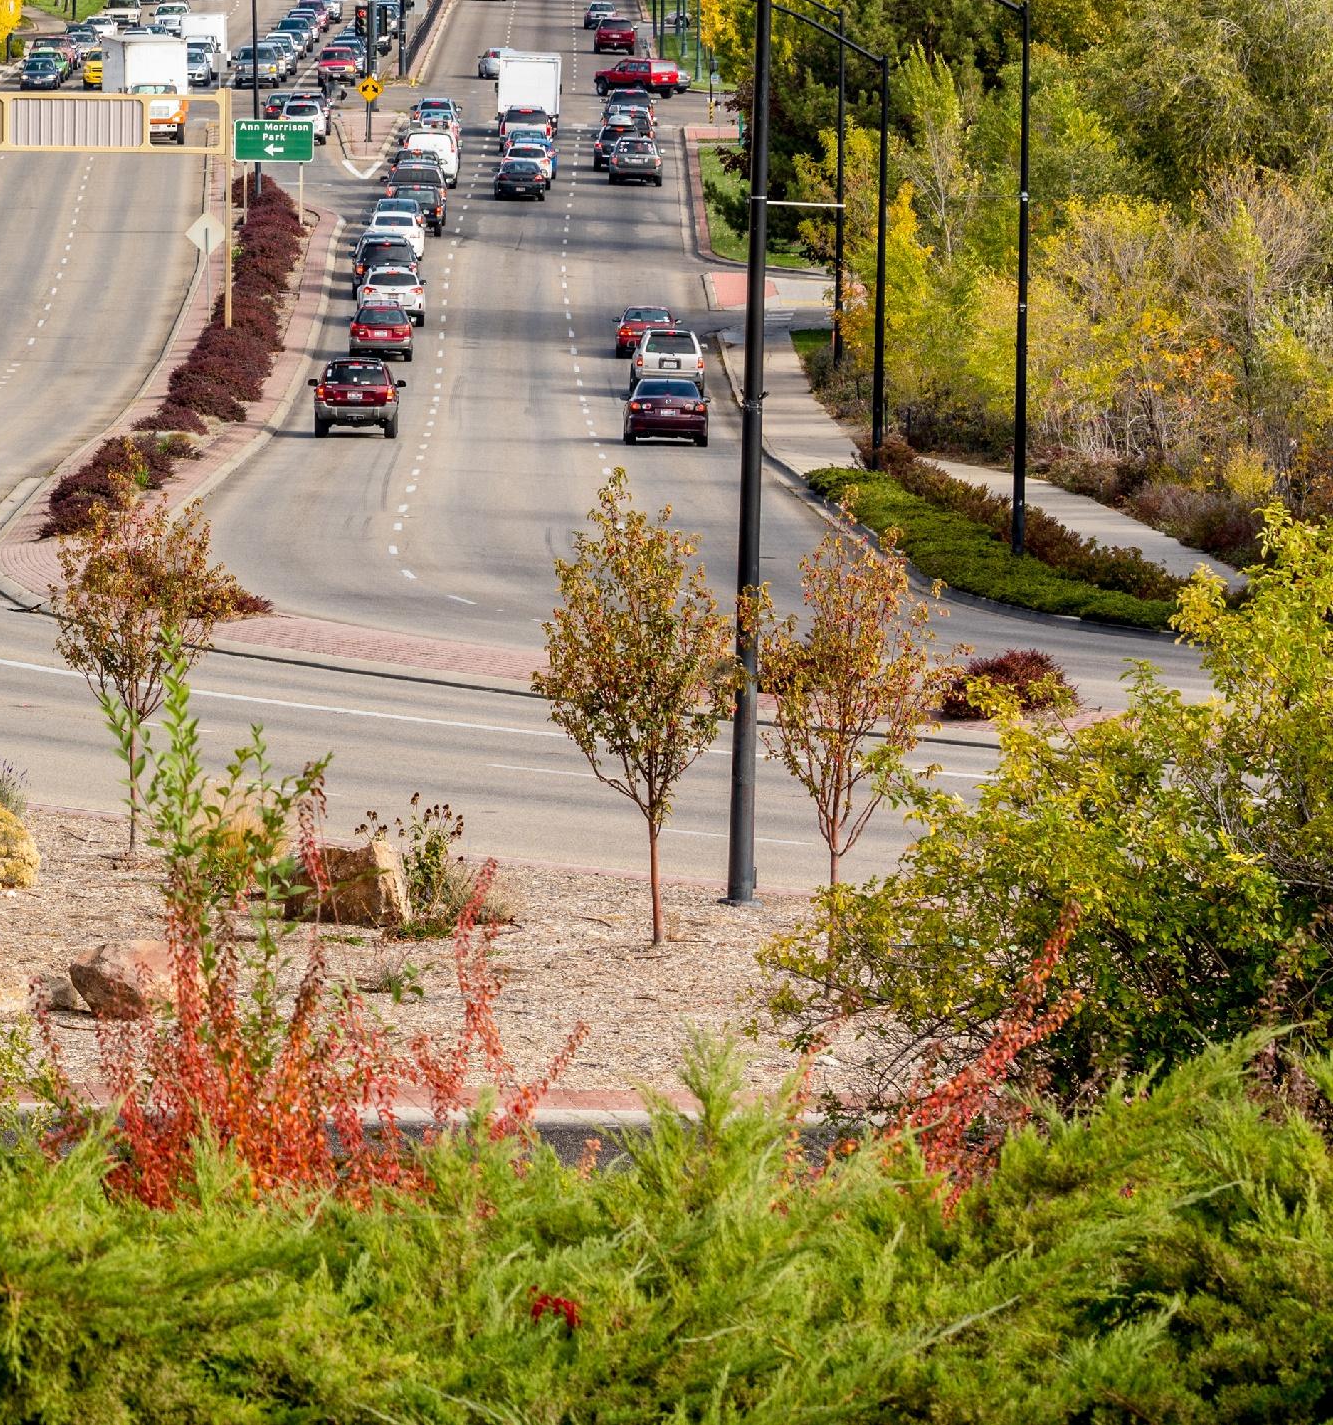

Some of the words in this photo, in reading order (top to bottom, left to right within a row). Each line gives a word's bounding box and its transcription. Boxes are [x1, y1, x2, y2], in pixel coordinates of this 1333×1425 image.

[240, 122, 260, 131] Ann
[264, 122, 309, 131] Morrison
[262, 133, 286, 141] Park
